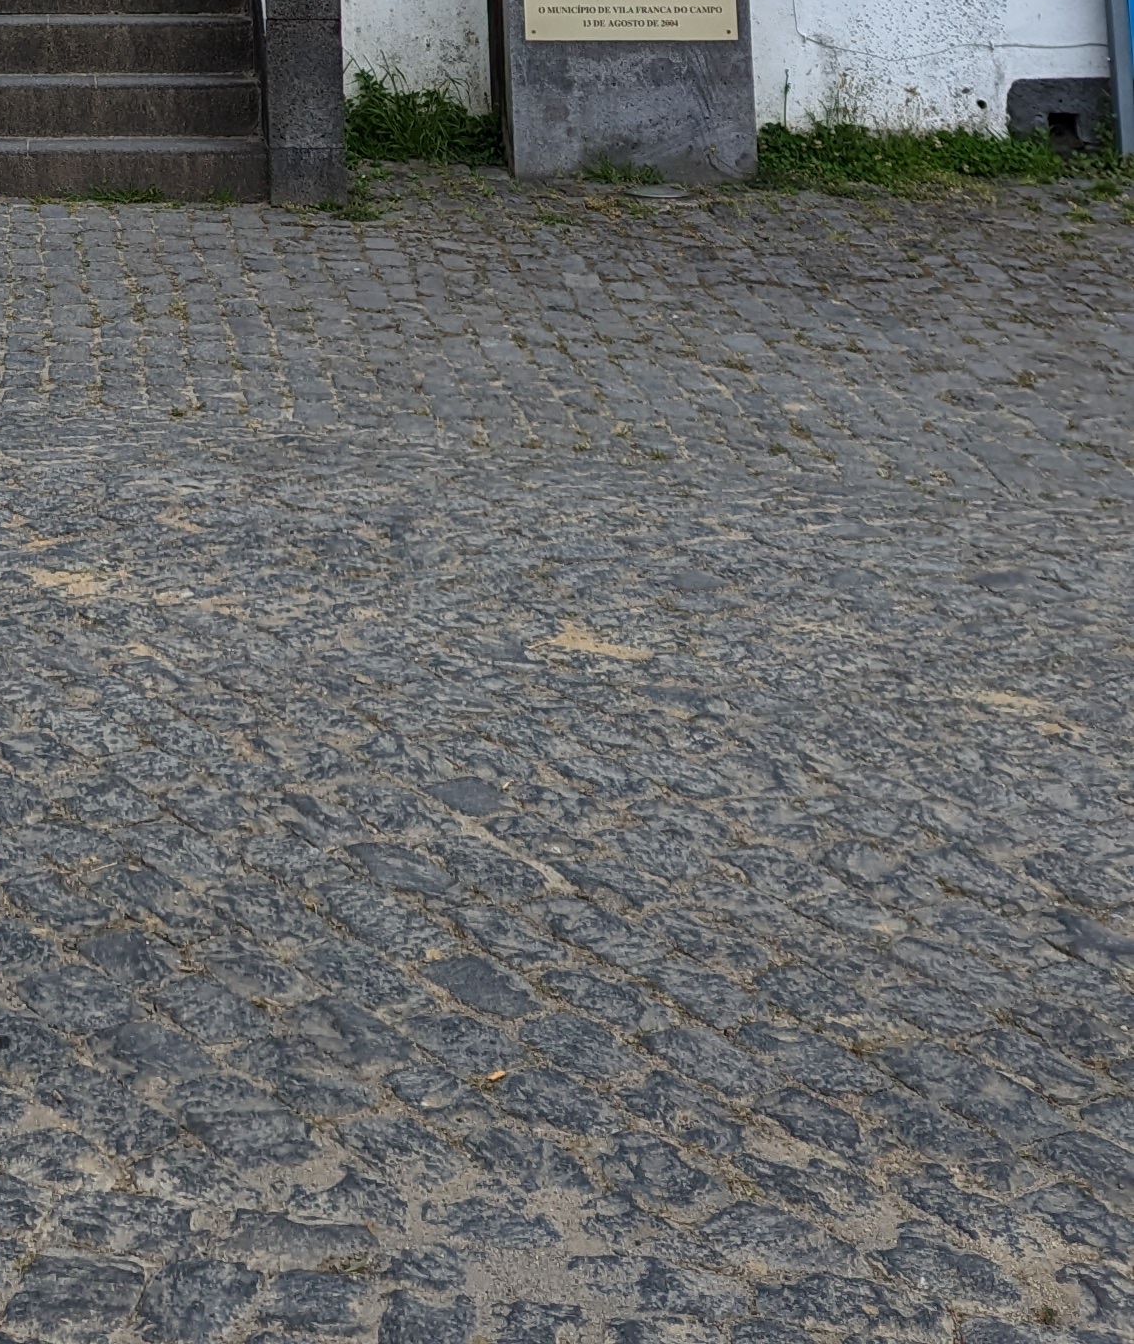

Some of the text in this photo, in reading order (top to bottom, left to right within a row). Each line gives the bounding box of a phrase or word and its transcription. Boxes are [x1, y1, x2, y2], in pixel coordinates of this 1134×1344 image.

[538, 4, 723, 14] O MUNICÍPIO DE VILA FRANCA DO CAMPO
[583, 19, 592, 28] 13
[593, 19, 606, 28] DE
[608, 19, 645, 28] AGOSTO
[646, 19, 659, 28] DE
